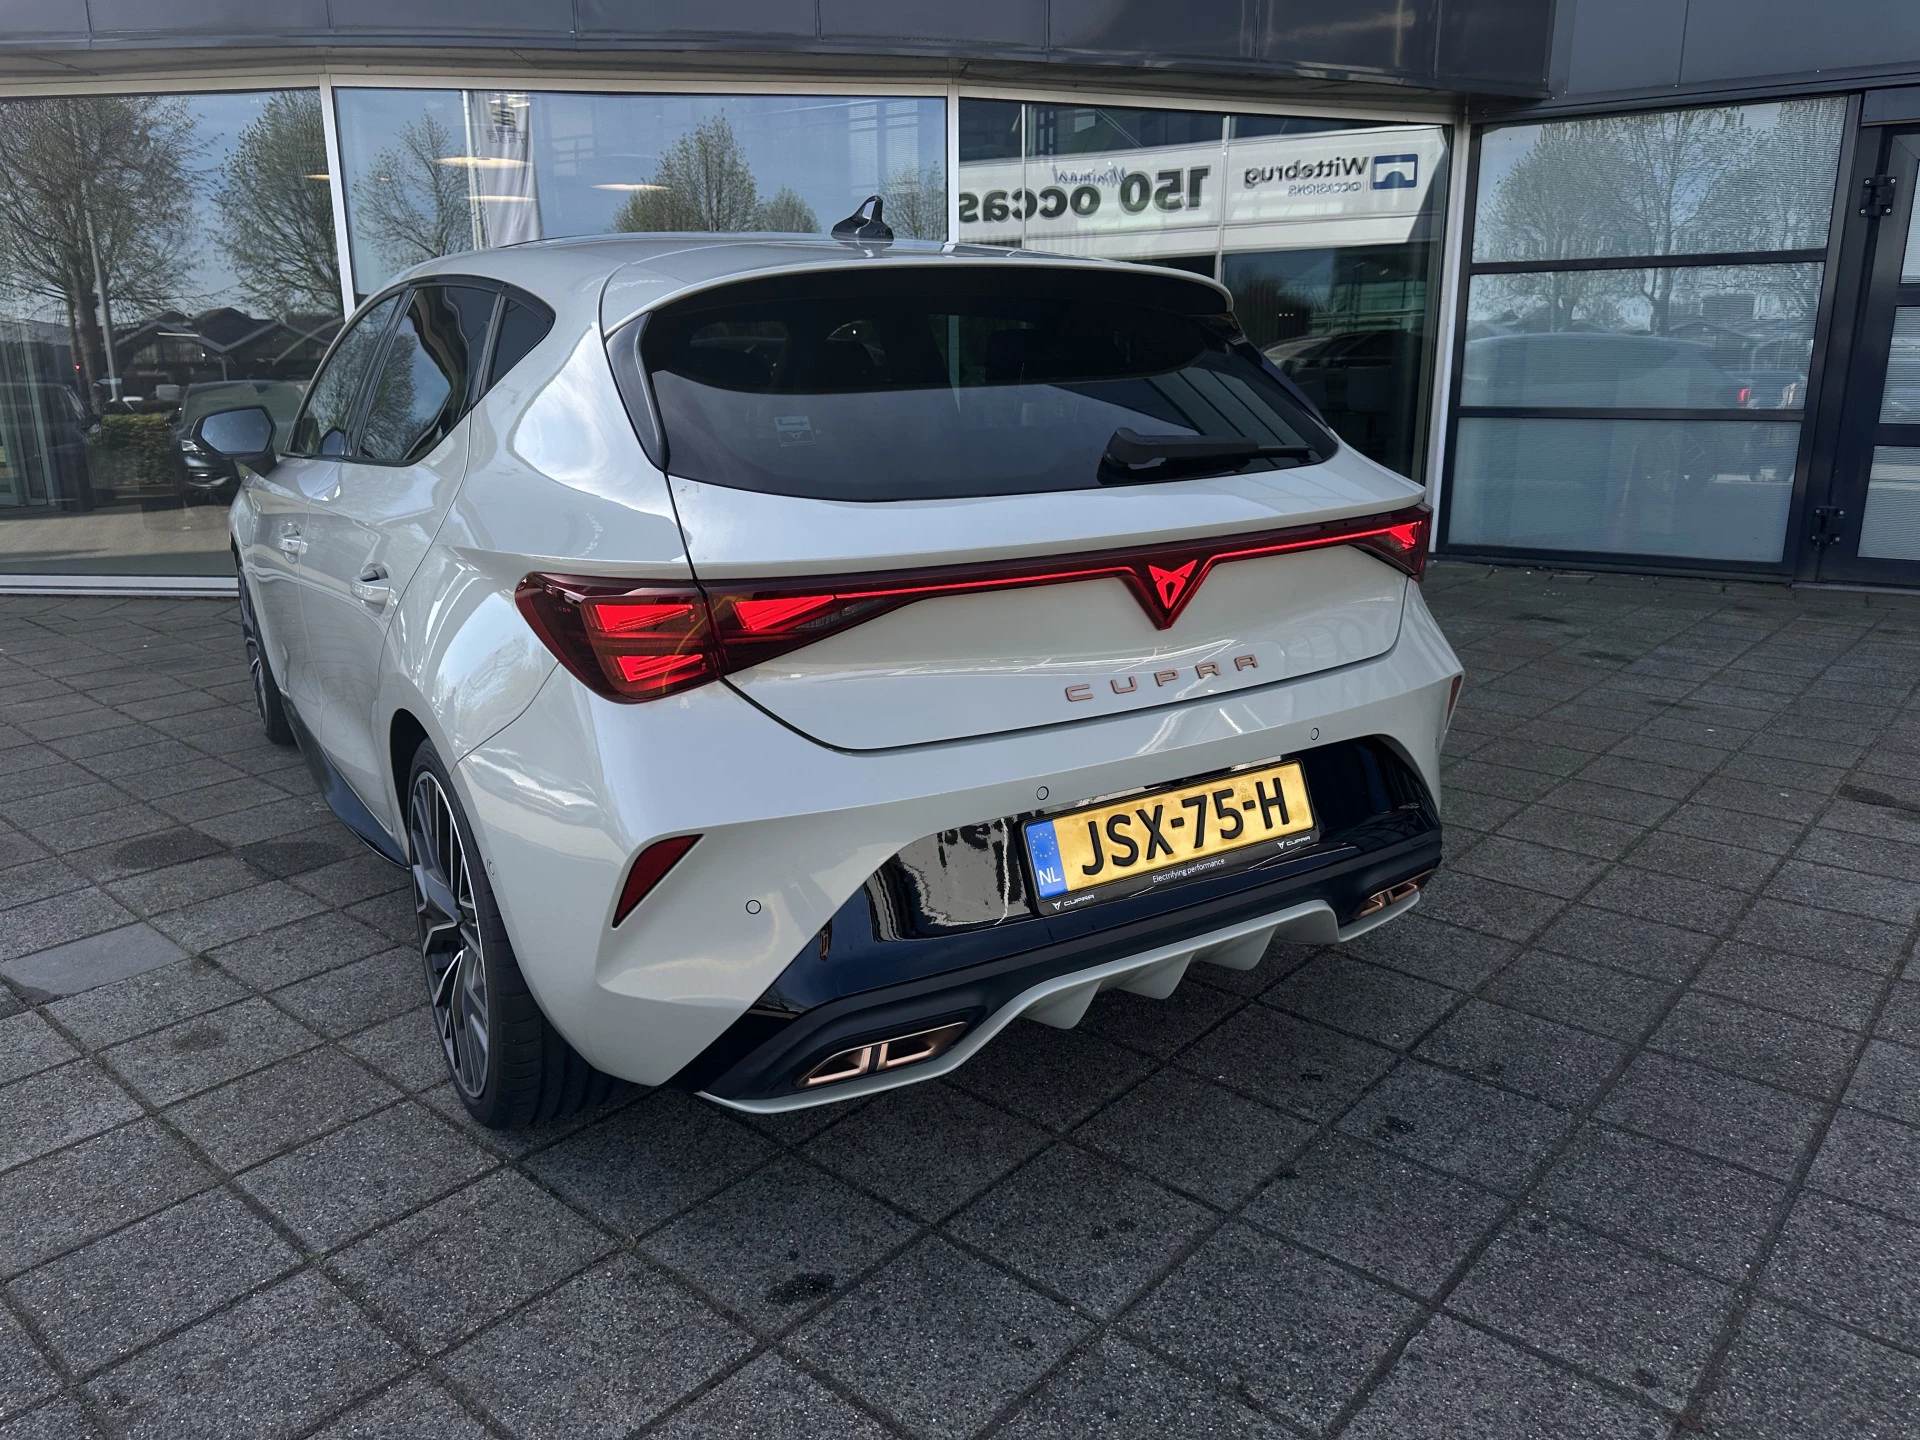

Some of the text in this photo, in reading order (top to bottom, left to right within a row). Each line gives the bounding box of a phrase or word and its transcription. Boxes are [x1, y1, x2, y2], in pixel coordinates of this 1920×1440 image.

[1065, 653, 1259, 702] CUPRA
[1082, 777, 1290, 876] JSX-75-H
[1286, 835, 1311, 847] CUPRA
[1038, 866, 1061, 886] NL
[1152, 868, 1187, 883] Electrifying
[1063, 894, 1095, 907] CUPRA
